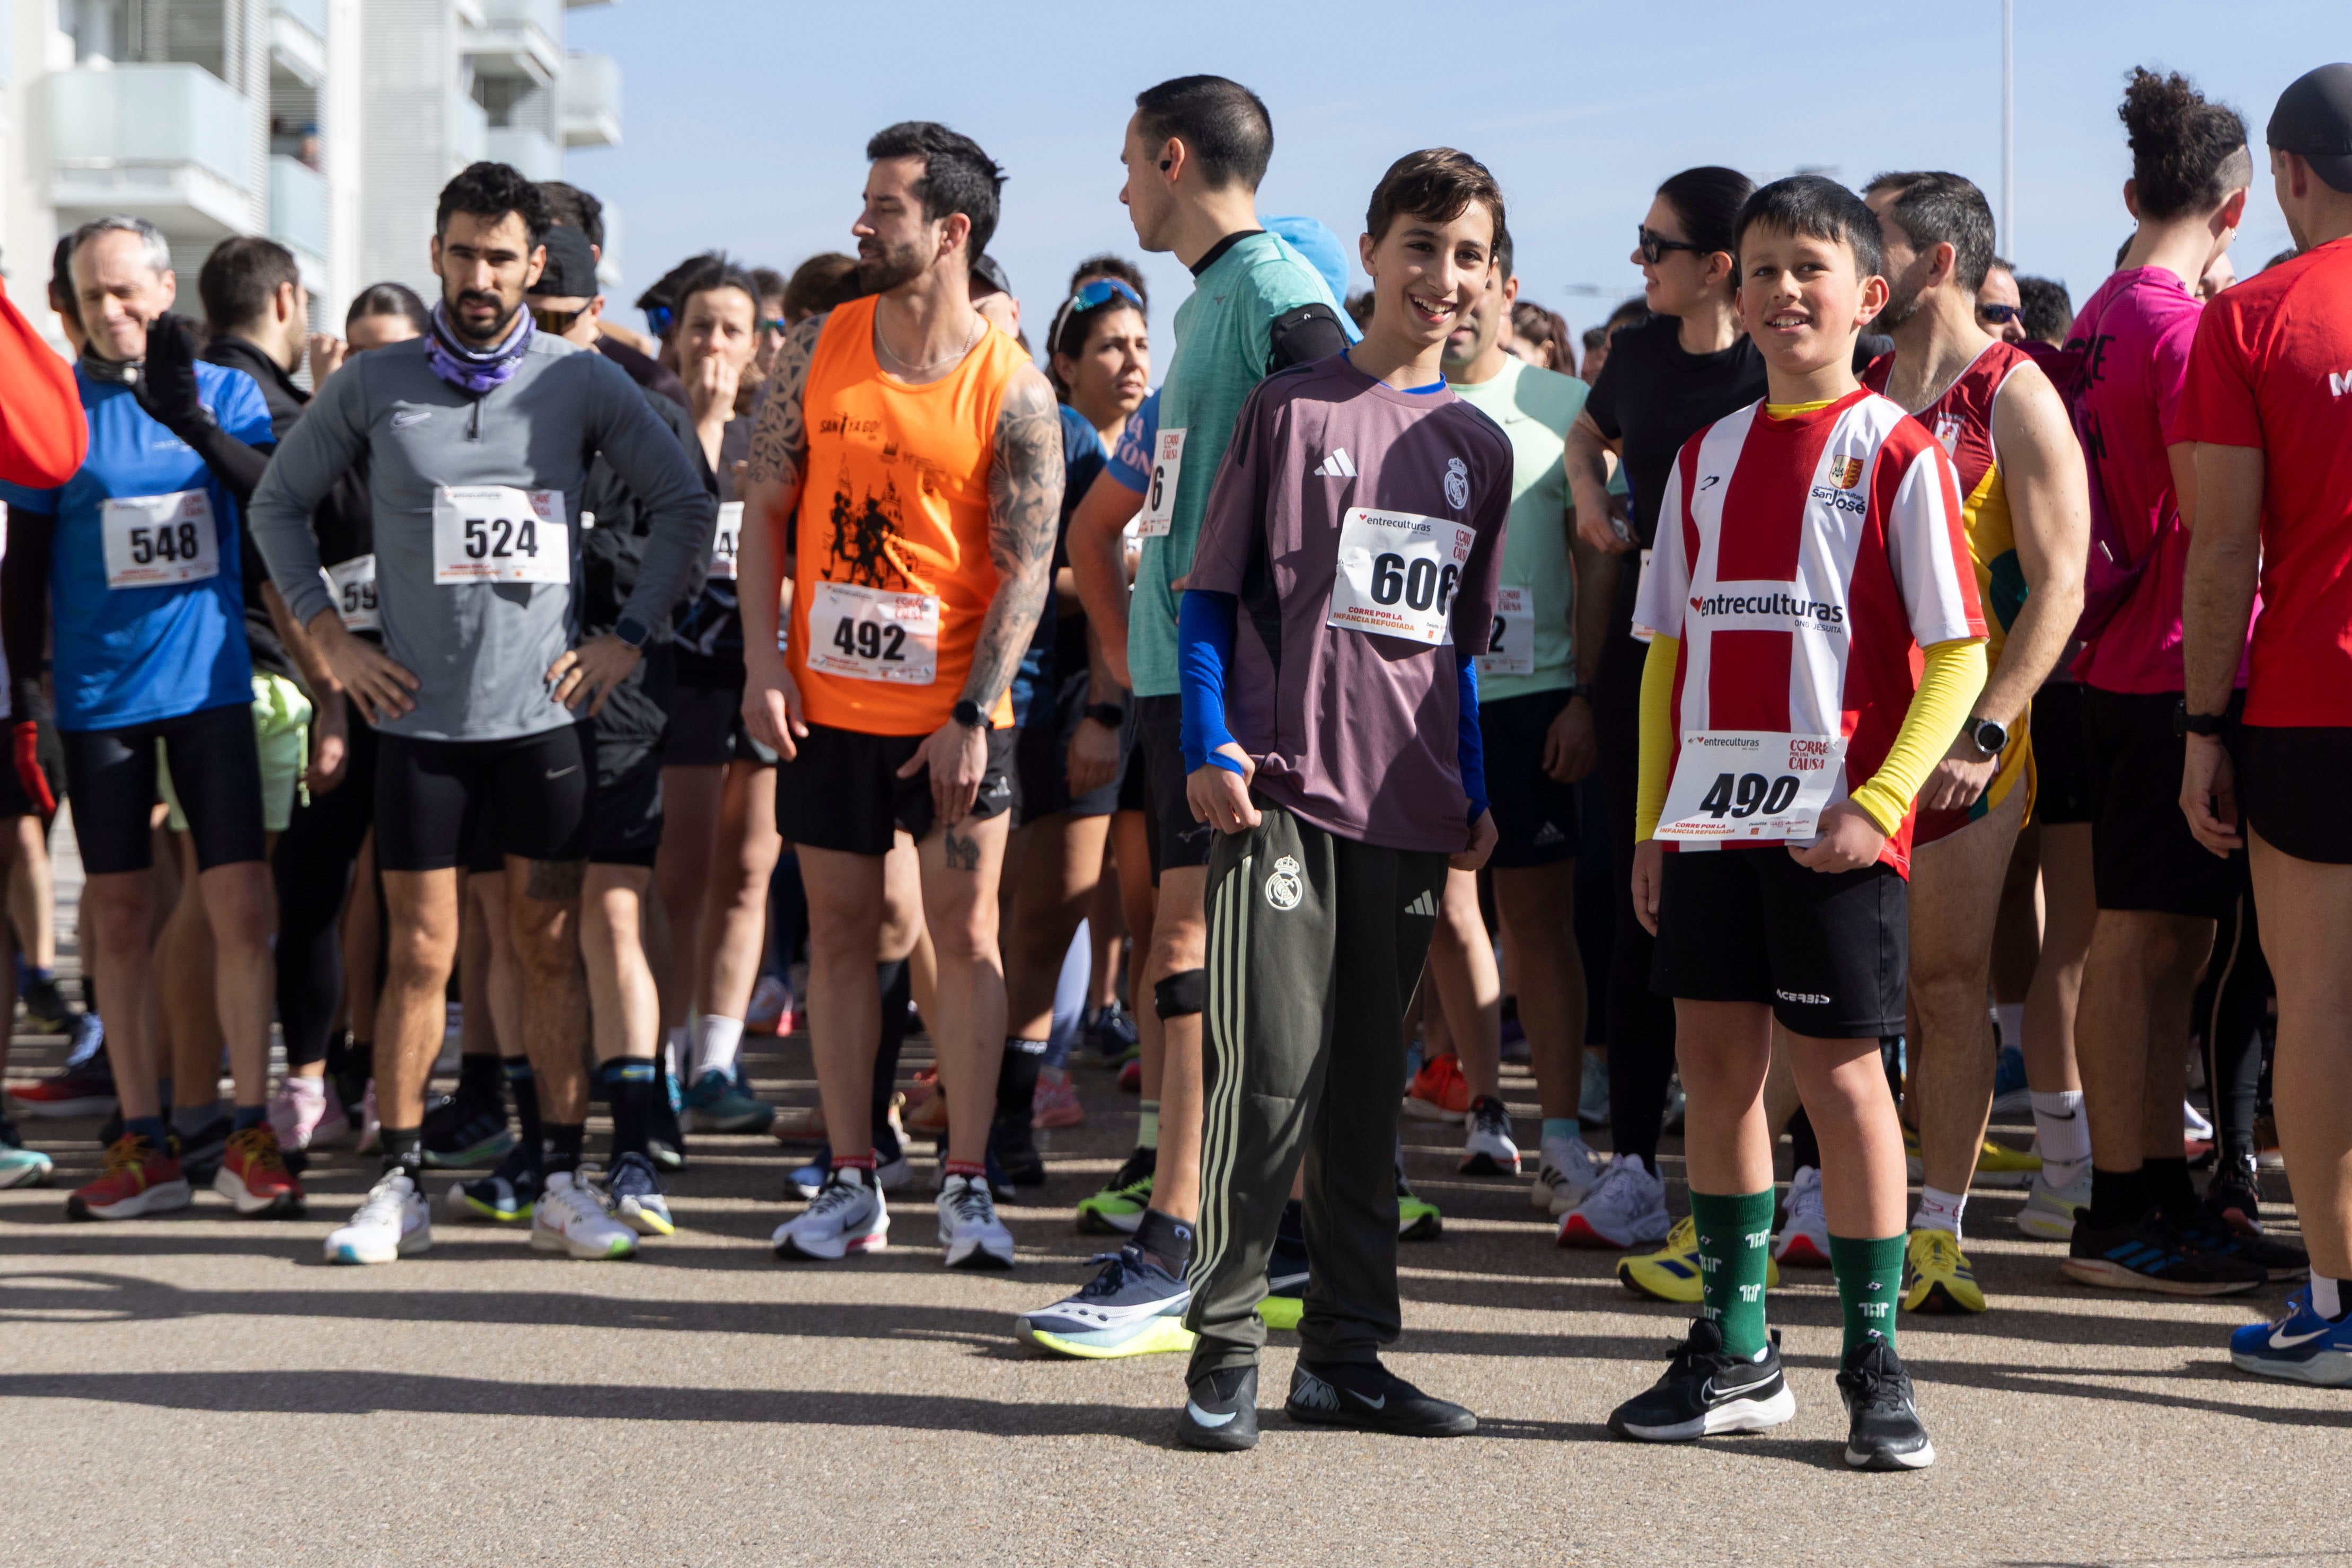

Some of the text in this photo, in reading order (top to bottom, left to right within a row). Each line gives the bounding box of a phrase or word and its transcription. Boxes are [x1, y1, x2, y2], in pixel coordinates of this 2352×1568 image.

[1811, 488, 1866, 514] San José
[1367, 516, 1431, 532] entreculturas
[130, 521, 198, 565] 548
[465, 519, 539, 559] 524
[1348, 606, 1374, 616] CORRE
[1701, 593, 1843, 623] entreculturas
[1333, 612, 1415, 631] INFANCIA REFUGIADA
[1794, 619, 1842, 635] ONG JESUITA
[833, 615, 906, 661] 492
[1704, 737, 1759, 747] entreculturas
[1790, 739, 1828, 755] CORRE
[1789, 756, 1825, 770] CAUSA
[1699, 772, 1800, 819] 490
